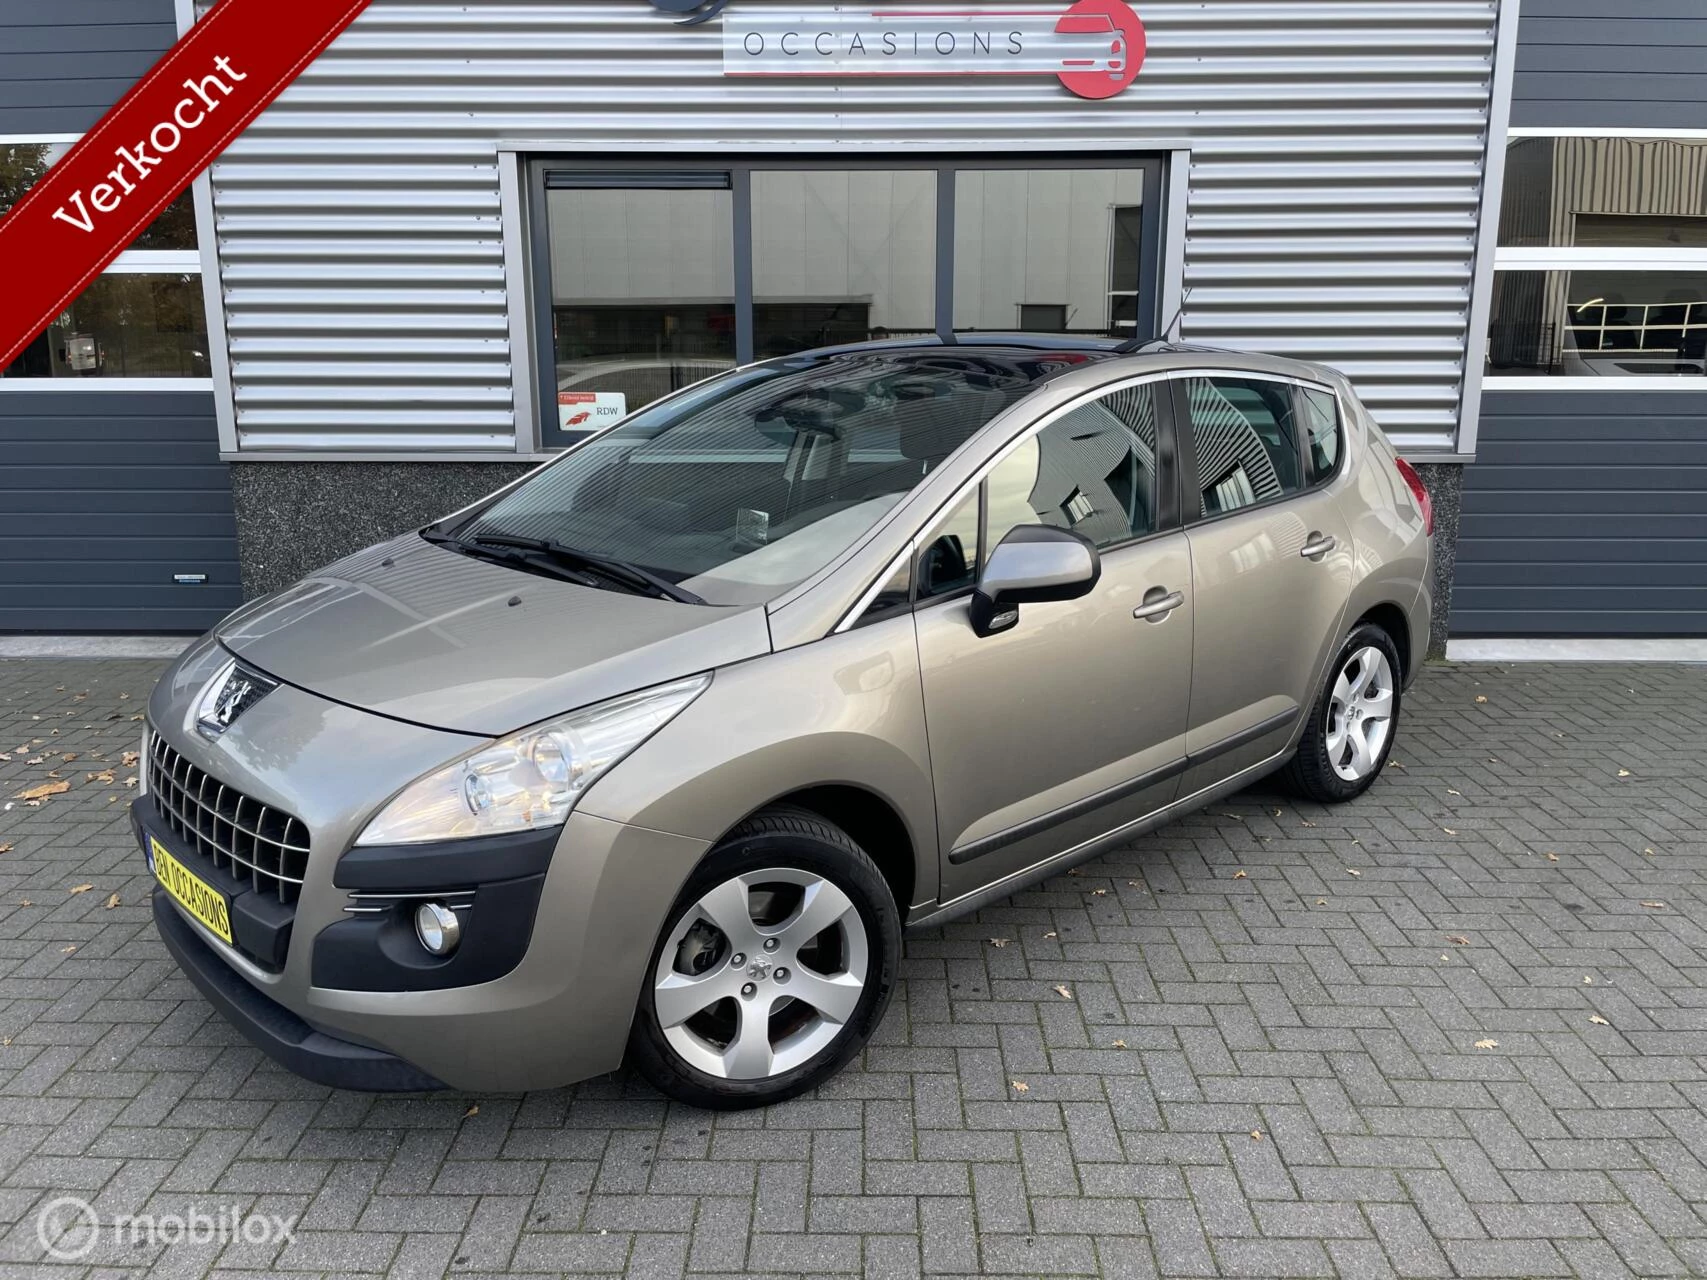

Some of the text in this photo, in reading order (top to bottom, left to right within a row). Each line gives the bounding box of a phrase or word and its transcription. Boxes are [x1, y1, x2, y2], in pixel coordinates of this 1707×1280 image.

[743, 30, 1025, 56] OCCASIONS
[596, 407, 618, 416] RDW
[171, 862, 229, 935] OCCASIONS
